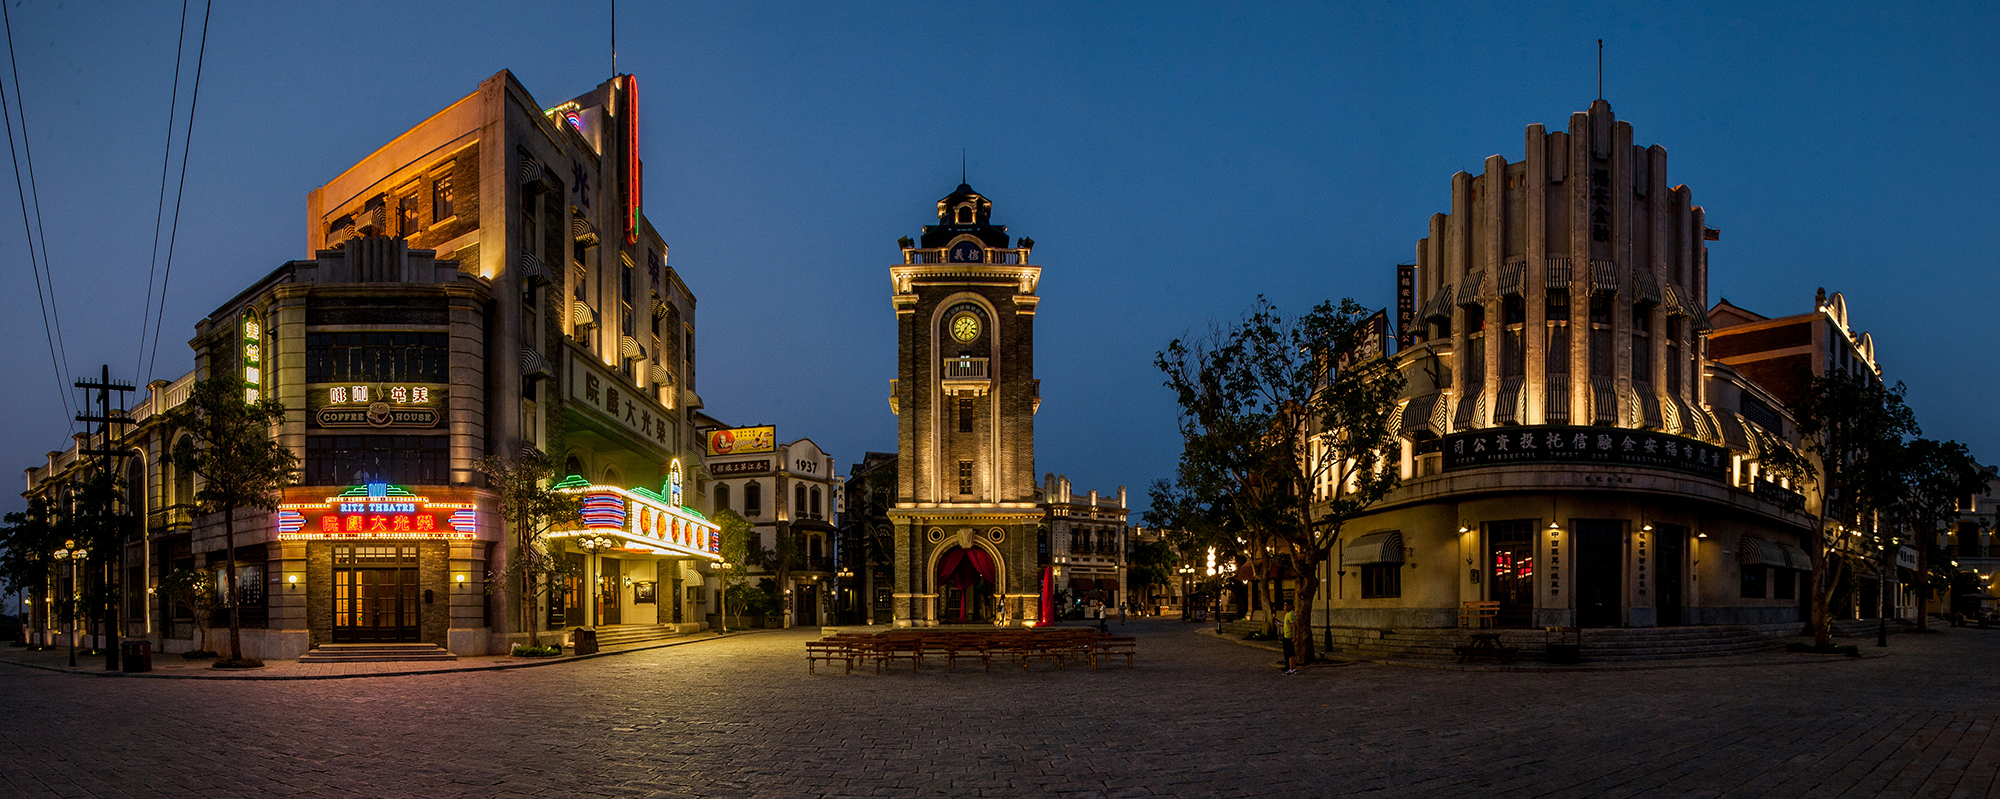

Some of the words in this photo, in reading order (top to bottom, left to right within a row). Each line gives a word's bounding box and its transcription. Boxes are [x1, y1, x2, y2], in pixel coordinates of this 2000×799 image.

[323, 413, 365, 421] COFFEE
[395, 412, 432, 421] HOUSE
[795, 458, 817, 474] 1937
[340, 503, 365, 512] RITZ
[369, 503, 415, 512] THEATRE
